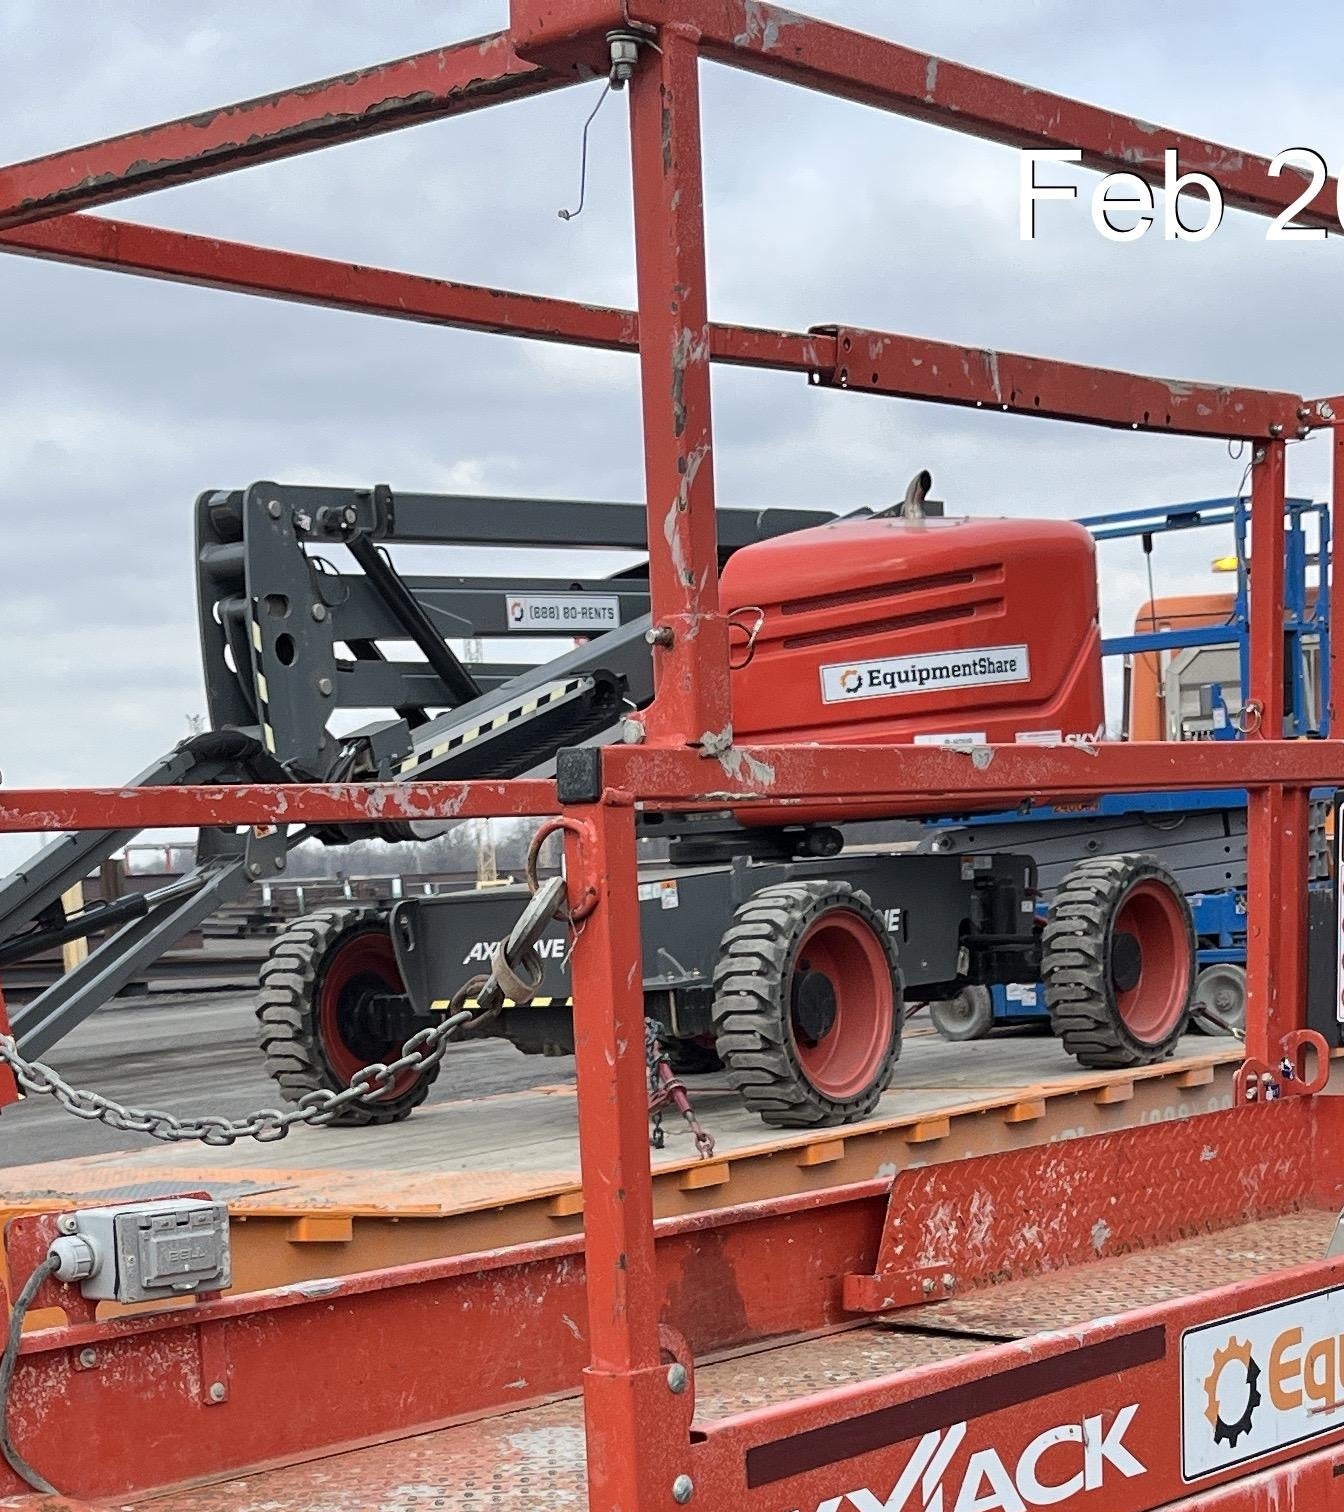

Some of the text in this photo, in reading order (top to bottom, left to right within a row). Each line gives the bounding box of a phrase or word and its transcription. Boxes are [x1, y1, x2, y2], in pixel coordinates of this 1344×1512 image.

[529, 606, 614, 620] (888) 80-RENTS
[868, 657, 1017, 689] EquipmentShare
